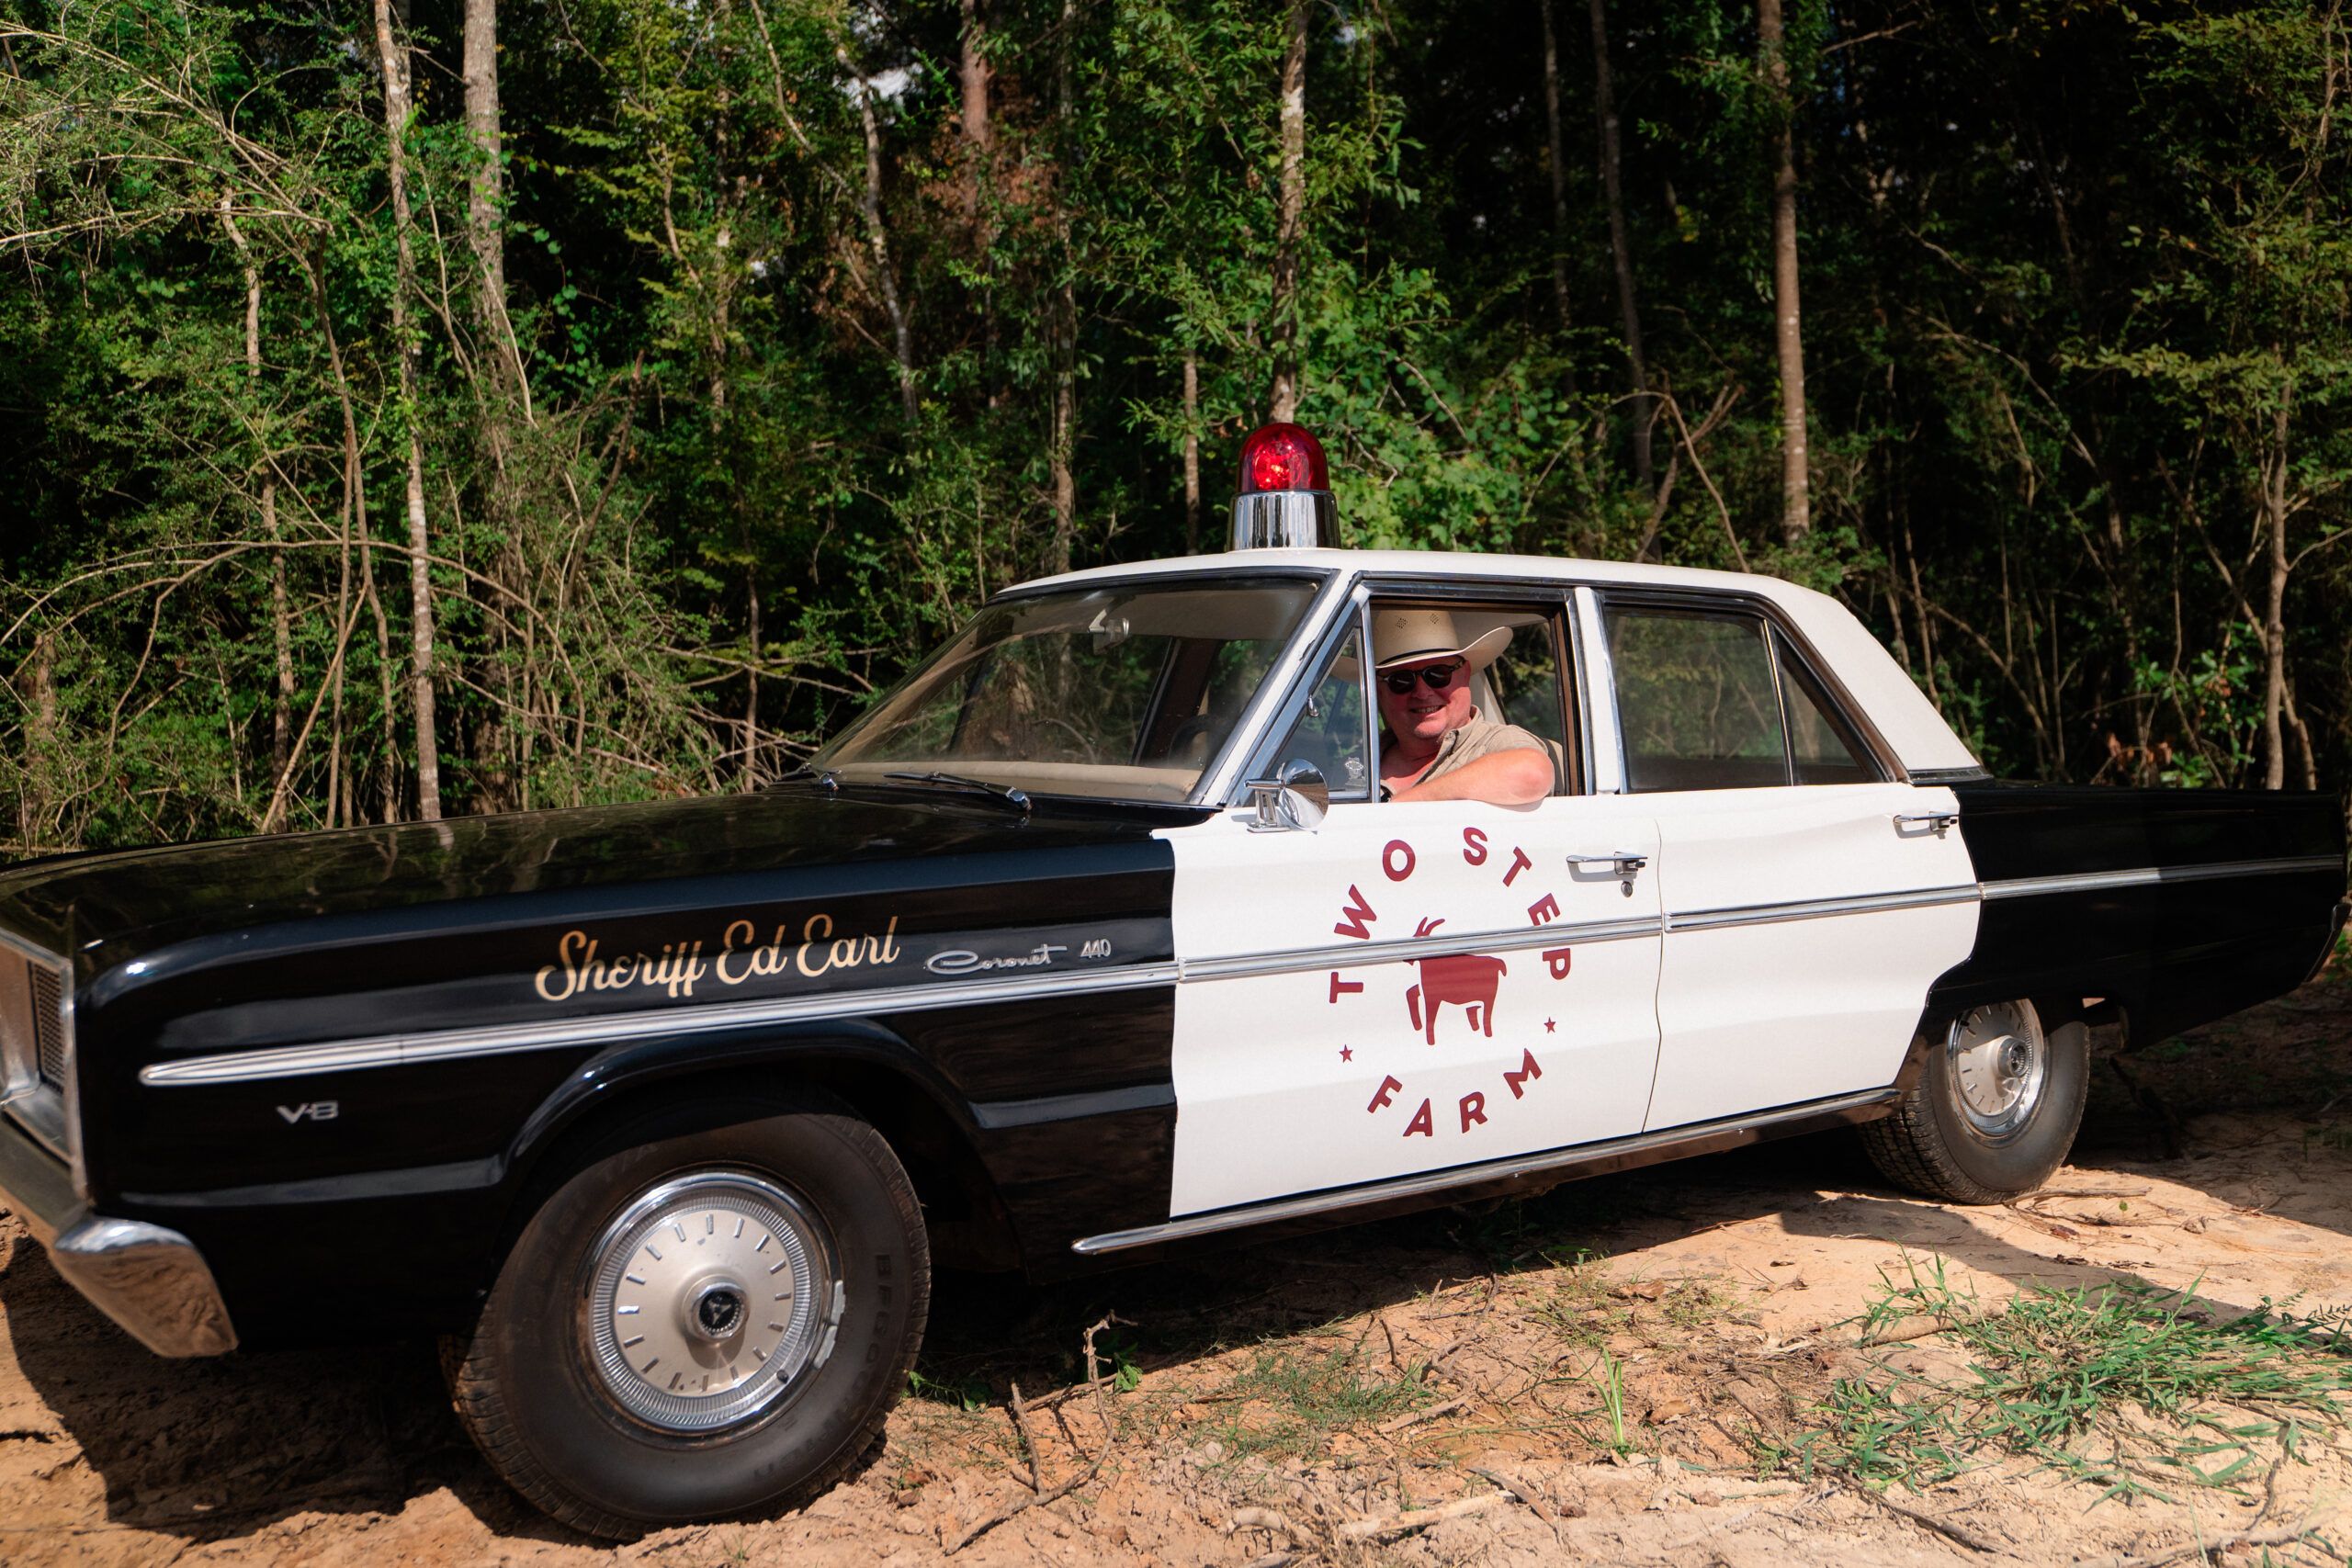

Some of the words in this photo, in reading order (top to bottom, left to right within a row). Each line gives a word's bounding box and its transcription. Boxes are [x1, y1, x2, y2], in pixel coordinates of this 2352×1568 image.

[535, 931, 707, 1000] Sheriff
[717, 919, 787, 985] Ed
[797, 914, 900, 977] Earl
[926, 944, 1068, 975] Coronet
[1080, 938, 1112, 959] 440
[1329, 840, 1417, 1005] TWO
[1463, 827, 1572, 981] STEP
[1367, 1048, 1543, 1137] FARM
